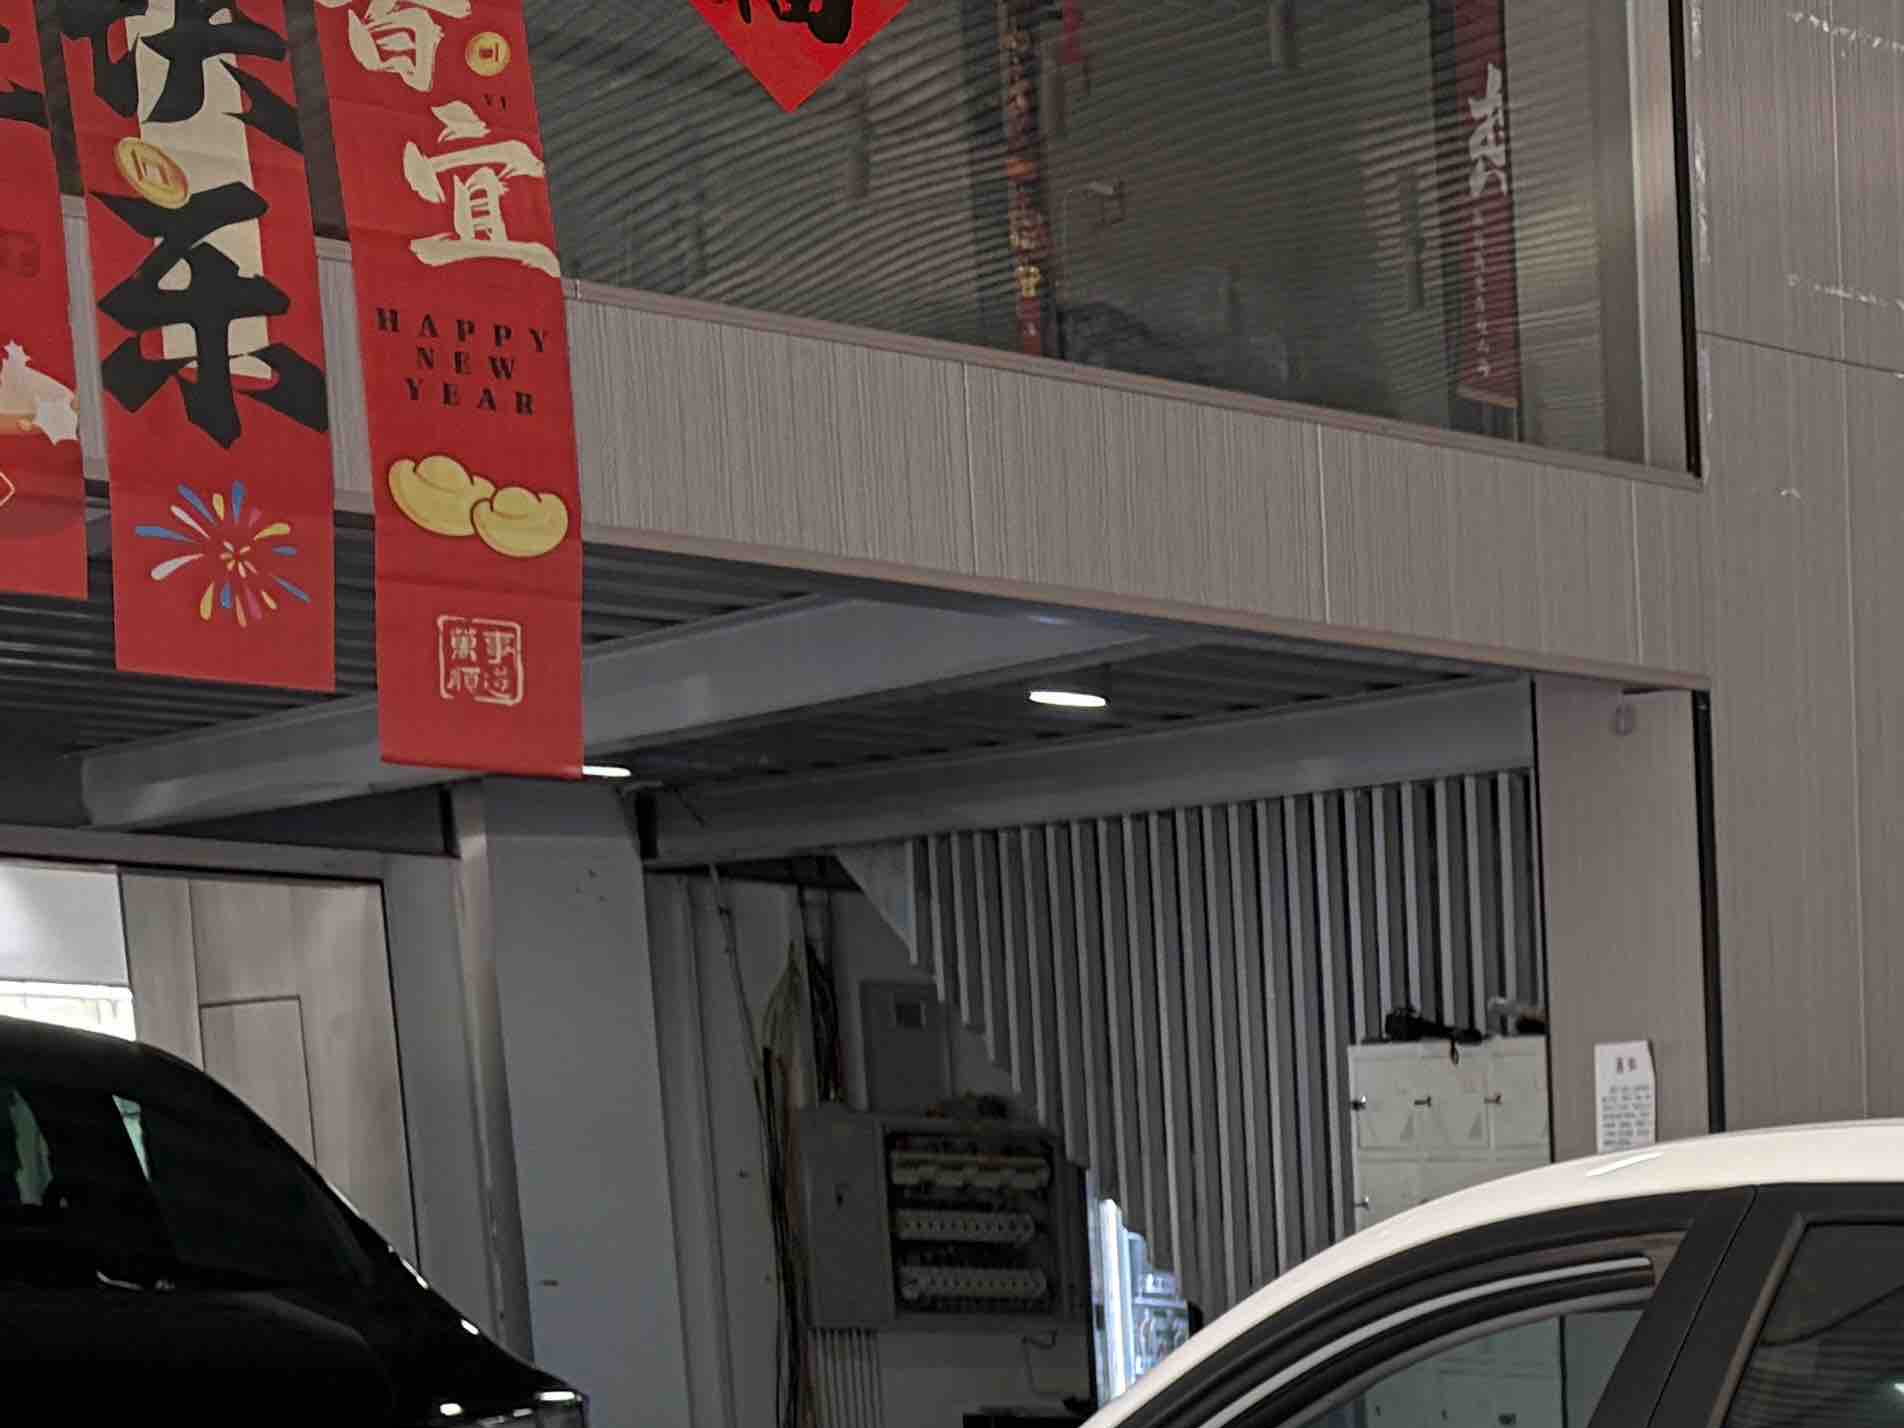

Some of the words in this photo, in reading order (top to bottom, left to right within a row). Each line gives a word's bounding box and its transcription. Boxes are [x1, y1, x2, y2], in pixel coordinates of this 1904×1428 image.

[376, 308, 549, 354] HAPPY
[416, 346, 515, 381] NEW
[403, 377, 535, 416] YEAR
